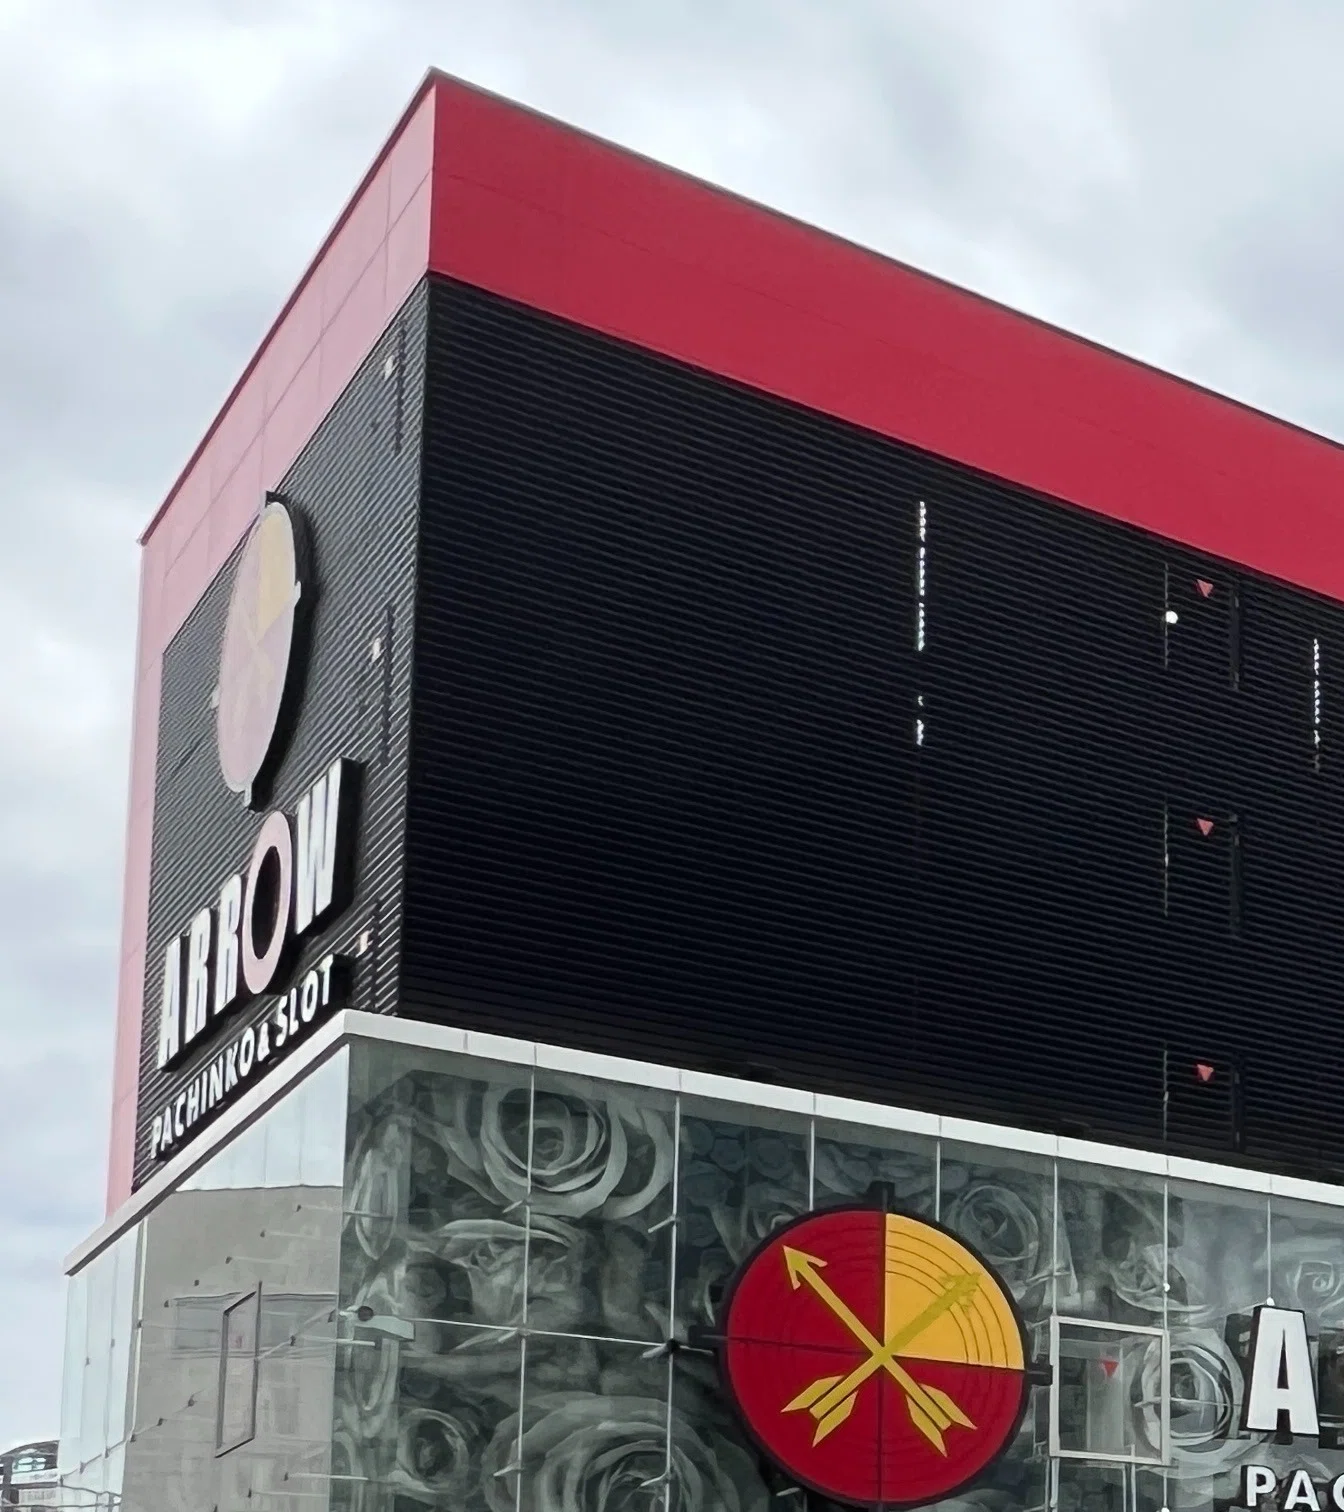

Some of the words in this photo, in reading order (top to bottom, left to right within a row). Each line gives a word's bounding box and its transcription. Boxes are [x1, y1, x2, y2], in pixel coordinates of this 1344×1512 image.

[157, 758, 342, 1070] ARROW
[151, 1027, 254, 1160] PACHINKO
[275, 954, 334, 1047] SLOT
